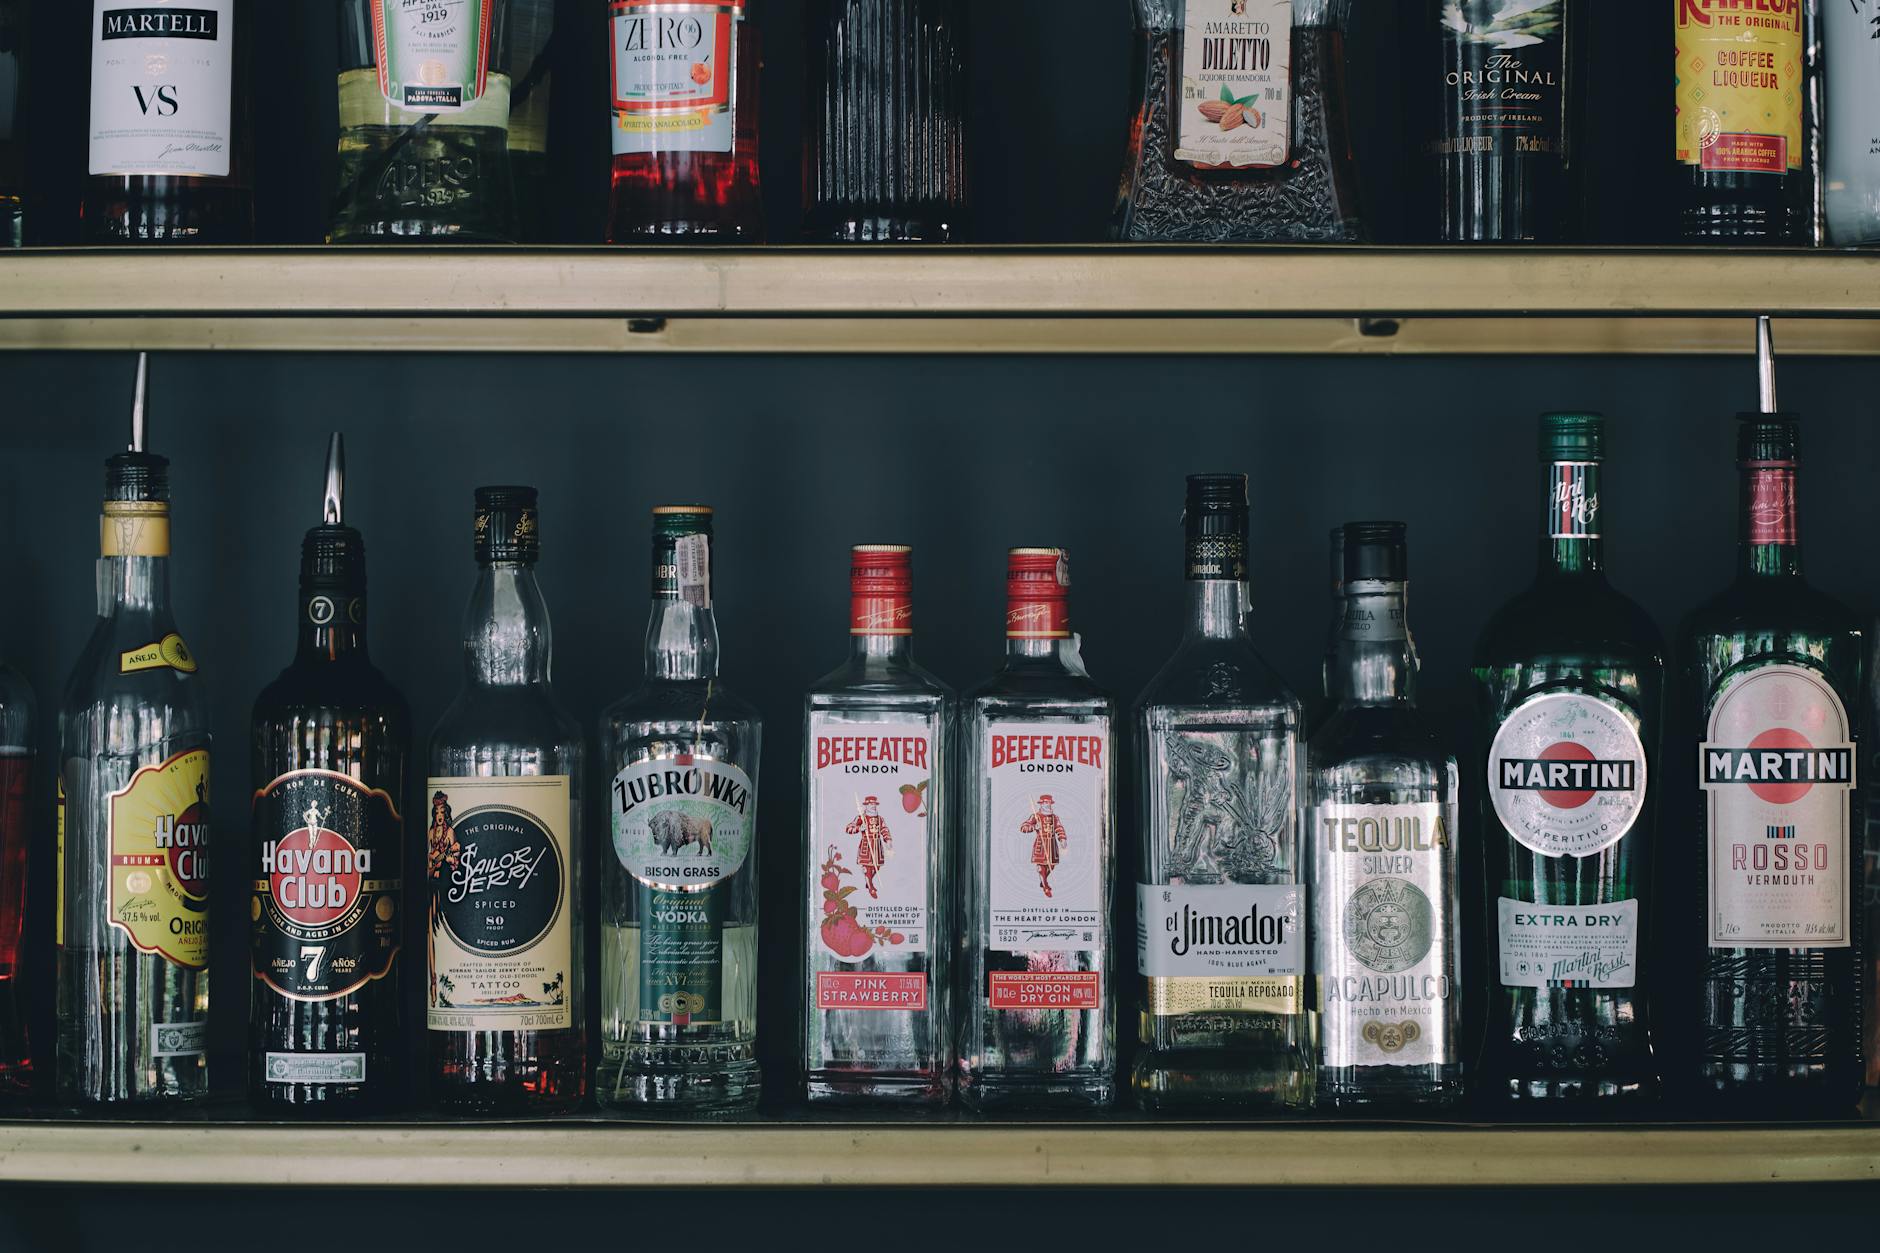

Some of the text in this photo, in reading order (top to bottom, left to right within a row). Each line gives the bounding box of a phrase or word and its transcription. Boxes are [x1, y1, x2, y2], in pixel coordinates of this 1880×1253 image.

[107, 14, 210, 34] MARTELL
[421, 10, 447, 23] 1919
[1718, 16, 1790, 30] THE ORIGINAL
[624, 17, 702, 51] ZERO
[1205, 22, 1269, 34] AMARETTO
[1202, 38, 1270, 71] DILETTO
[1484, 54, 1522, 69] The
[1718, 50, 1774, 69] COFFEE
[1199, 73, 1271, 82] LIQUORE DI MANDORLA
[1446, 70, 1555, 85] ORIGINAL
[1714, 70, 1778, 90] LIQUEUR
[131, 85, 178, 116] VS
[1461, 88, 1542, 100] Irish Cream
[1461, 136, 1493, 154] LIQUEUR
[1515, 135, 1528, 151] 17%
[1758, 149, 1776, 158] COFFEE
[315, 602, 326, 618] 7
[129, 652, 157, 664] AÑEJO
[818, 737, 927, 770] BEEFEATER
[992, 735, 1102, 769] BEEFEATER
[845, 765, 898, 773] LONDON
[1020, 764, 1073, 772] LONDON
[1709, 752, 1847, 780] MARTINI
[1504, 762, 1630, 787] MARTINI
[286, 780, 304, 790] RON
[334, 783, 357, 798] CUBA
[614, 768, 747, 815] ŻUBRÓWKA
[465, 824, 524, 836] THE ORIGINAL
[1324, 816, 1449, 852] TEQUILA
[1524, 824, 1608, 843] L'APERITIVO
[124, 856, 150, 865] RHUM
[262, 840, 371, 874] Havana
[452, 843, 532, 885] SAILOR
[1732, 844, 1827, 870] ROSSO
[645, 866, 720, 876] BISON GRASS
[1363, 855, 1413, 875] SILVER
[448, 848, 546, 903] JERRY
[1748, 875, 1814, 885] VERMOUTH
[166, 882, 182, 901] MADE
[280, 876, 347, 908] Club
[653, 895, 710, 908] Original
[122, 912, 161, 921] 37.5 % vol.
[269, 907, 362, 938] MADE AND AGED IN CUBA
[486, 916, 504, 926] 80
[656, 911, 708, 923] VODKA
[1515, 914, 1622, 926] EXTRA DRY
[1171, 904, 1289, 956] Jimador
[178, 936, 198, 944] AÑEJO
[272, 957, 296, 967] AÑEJO
[300, 946, 327, 983] 7
[332, 957, 356, 967] AÑOS
[1552, 947, 1601, 981] Martini
[1593, 952, 1630, 982] Rossi
[664, 976, 687, 985] XVI
[855, 979, 887, 989] PINK
[1210, 986, 1294, 998] TEQUILA REPOSADO
[1327, 975, 1449, 1002] ACAPULCO
[823, 991, 919, 1002] STRAWBERRY
[1020, 994, 1070, 1003] DRY GIN
[1352, 1007, 1380, 1016] Hecho
[1400, 1006, 1432, 1015] Mexico
[521, 1016, 534, 1025] 70cl
